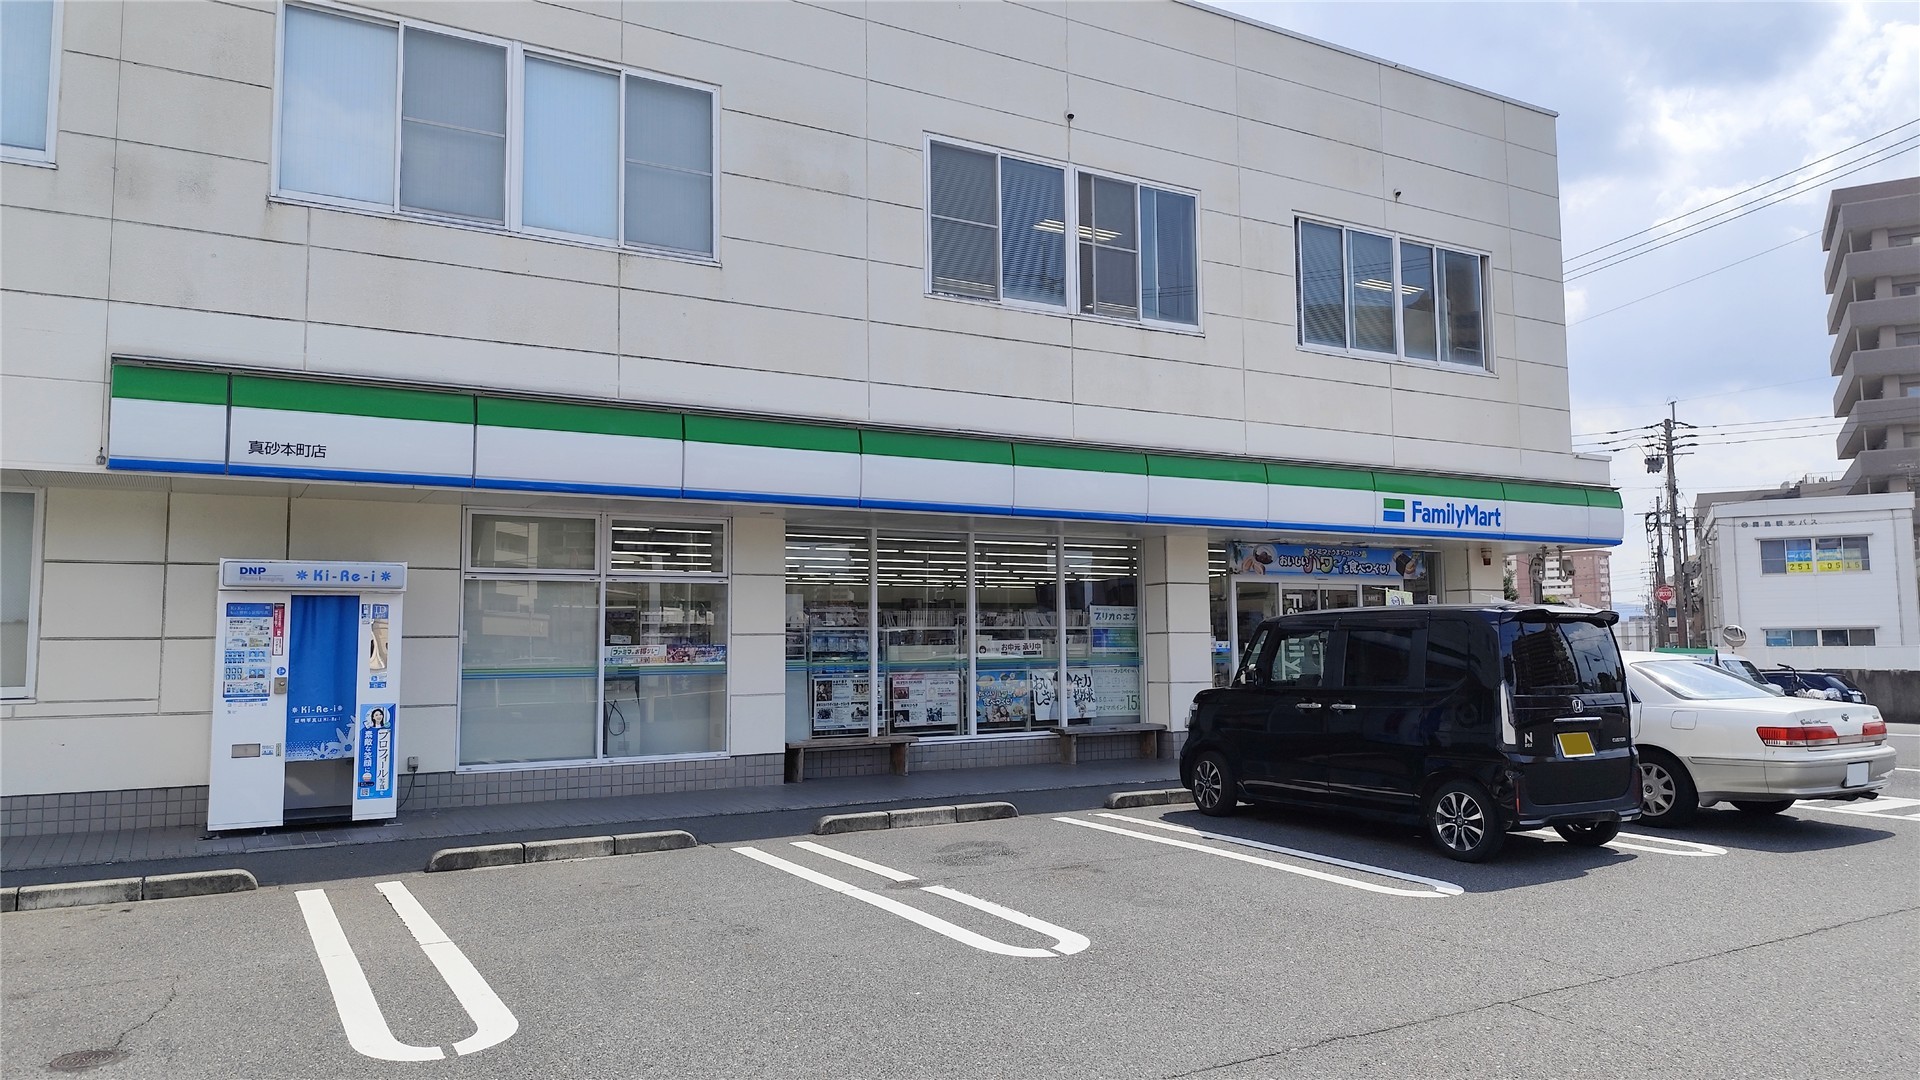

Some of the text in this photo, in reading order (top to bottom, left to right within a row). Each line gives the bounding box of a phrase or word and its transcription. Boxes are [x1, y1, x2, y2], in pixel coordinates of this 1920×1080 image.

[248, 440, 326, 459] 真砂本町店
[1412, 500, 1501, 528] FamilyMart
[239, 566, 376, 582] DNP Ki-Re-i
[1001, 643, 1021, 651] お中元
[1022, 642, 1041, 651] 承り中
[1072, 674, 1092, 688] 全力
[301, 705, 336, 714] Ki-Re-i
[363, 730, 373, 773] 素敵な笑顔に
